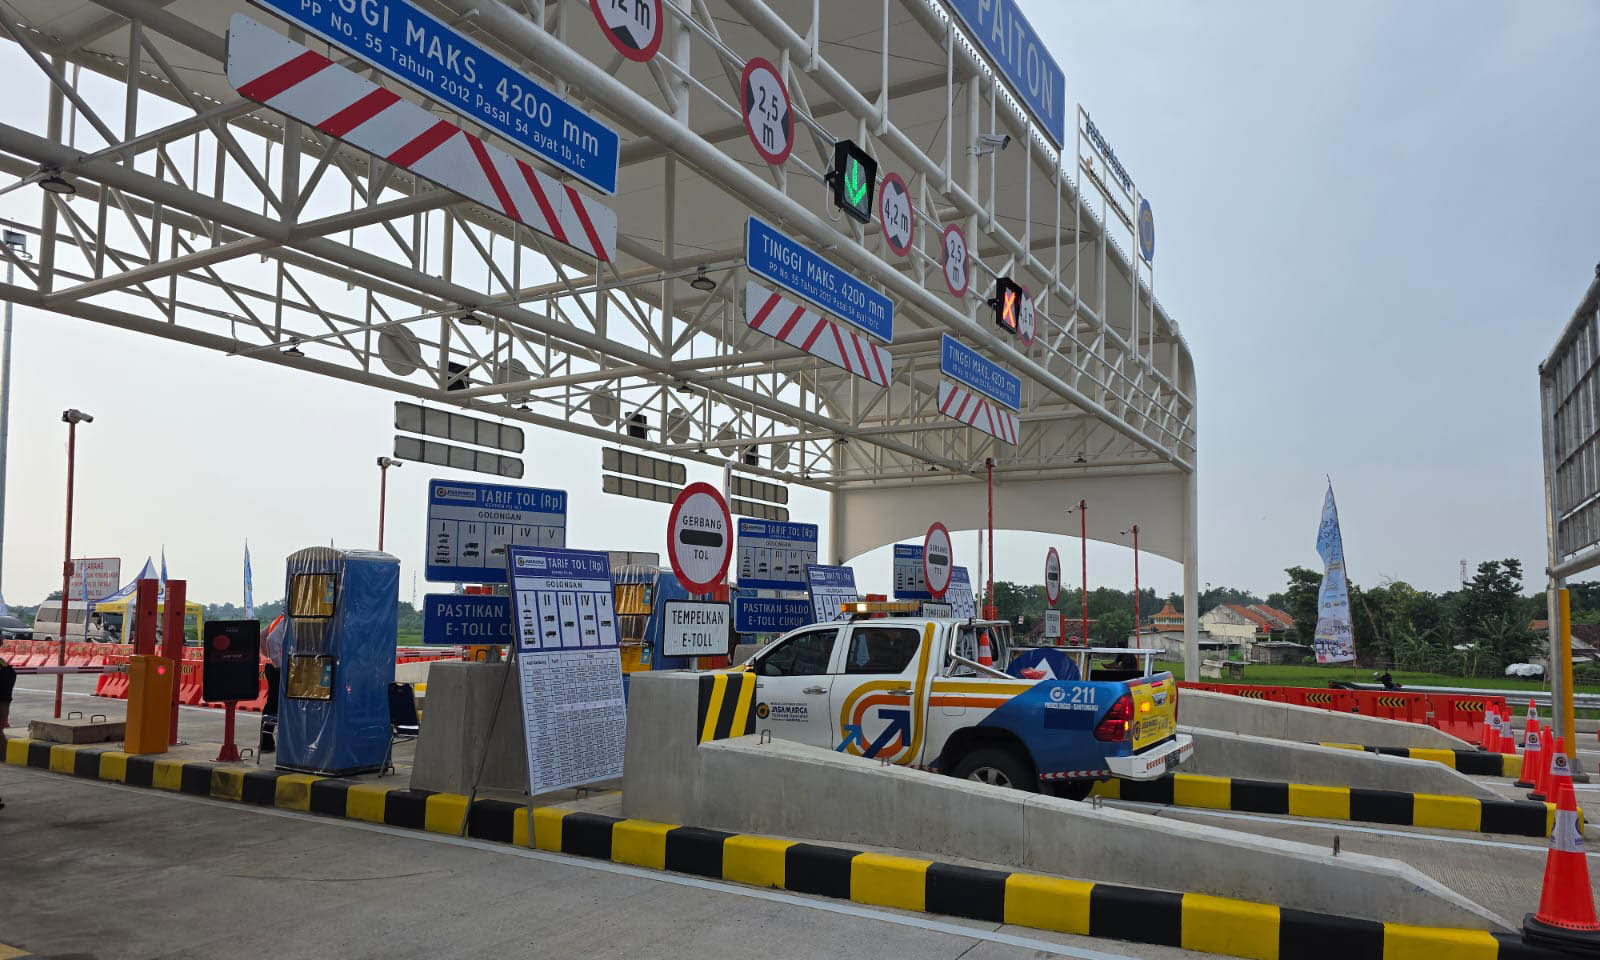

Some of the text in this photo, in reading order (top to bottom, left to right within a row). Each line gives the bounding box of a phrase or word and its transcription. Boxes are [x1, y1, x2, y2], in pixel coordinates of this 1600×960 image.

[634, 0, 650, 30] m
[330, 13, 358, 41] No.
[365, 33, 383, 54] 55
[390, 46, 434, 83] Tahun
[440, 75, 470, 103] 2012
[476, 94, 511, 126] Pasal
[515, 118, 529, 136] 54
[534, 130, 558, 153] ayat
[405, 18, 484, 89] MAKS.
[495, 77, 552, 128] 4200
[562, 119, 599, 157] mm
[758, 85, 779, 122] 2,5
[762, 122, 775, 150] m
[884, 197, 909, 234] 4,2 m
[950, 239, 962, 264] 2,5
[762, 233, 885, 320] TINGGI MAKS. 4200 mm
[952, 268, 960, 283] m
[480, 489, 513, 504] TARIF
[516, 492, 537, 506] TOL
[540, 494, 563, 511] (Rp)
[478, 510, 522, 521] GOLONGAN
[682, 515, 722, 530] GERBANG
[442, 521, 555, 539] I II III IV V
[767, 524, 786, 536] TARIF
[788, 526, 800, 537] TOL
[693, 549, 709, 560] TOL
[547, 557, 569, 569] TARIF
[571, 559, 587, 570] TOL
[589, 559, 604, 573] (Rp)
[545, 580, 583, 589] GOLONGAN
[523, 593, 607, 607] I II III IV V
[437, 603, 504, 618] PASTIKAN
[743, 602, 809, 614] PASTIKAN SALDO
[672, 610, 724, 625] TEMPELKAN
[748, 615, 804, 627] E-TOLL CUKUP
[446, 622, 494, 636] E-TOLL
[682, 633, 713, 647] E-TOLL
